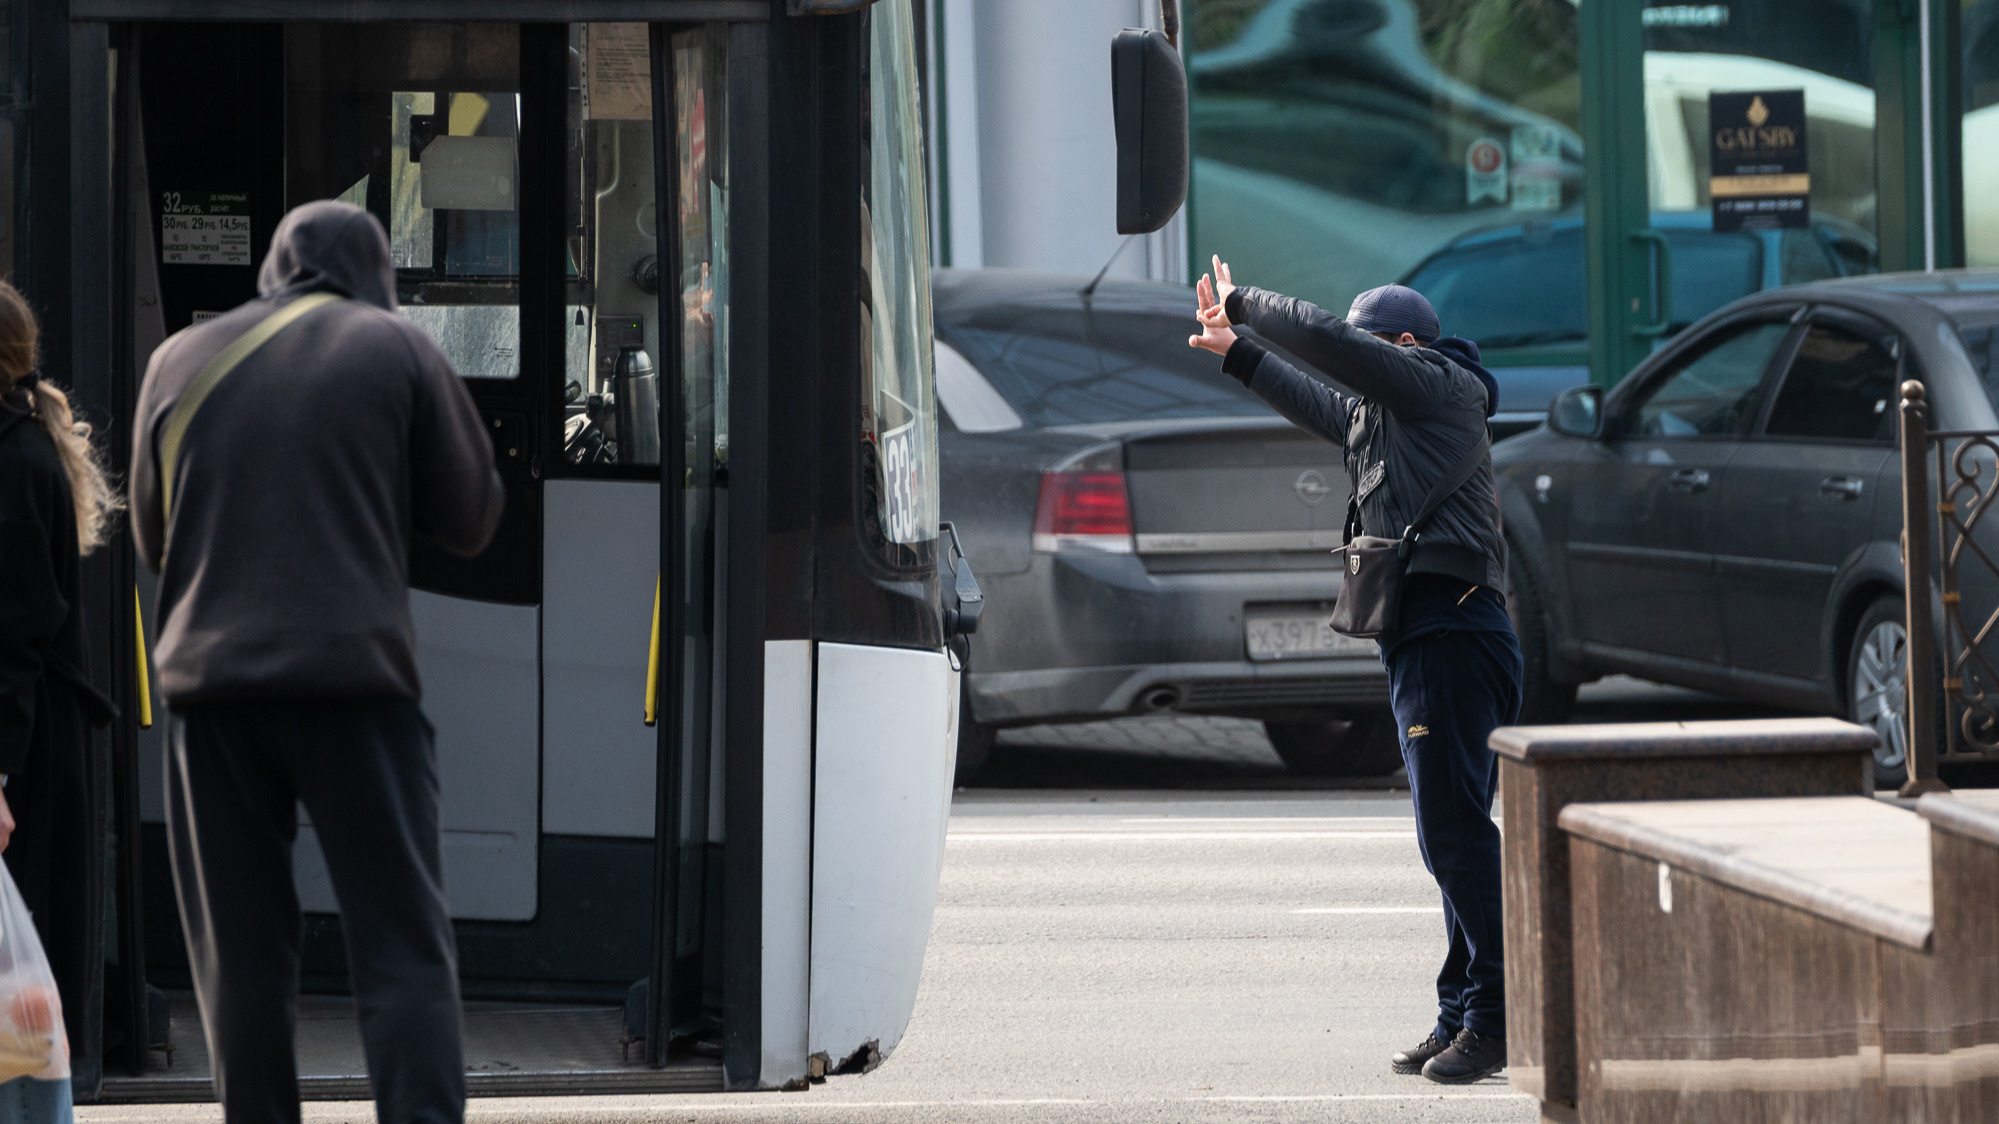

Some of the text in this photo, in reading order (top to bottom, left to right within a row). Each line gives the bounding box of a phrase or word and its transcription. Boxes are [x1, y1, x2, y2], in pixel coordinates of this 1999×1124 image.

[1716, 126, 1798, 150] GATSBY
[163, 191, 181, 213] 32
[163, 217, 175, 229] 30
[192, 217, 204, 229] 29
[888, 435, 913, 544] 33
